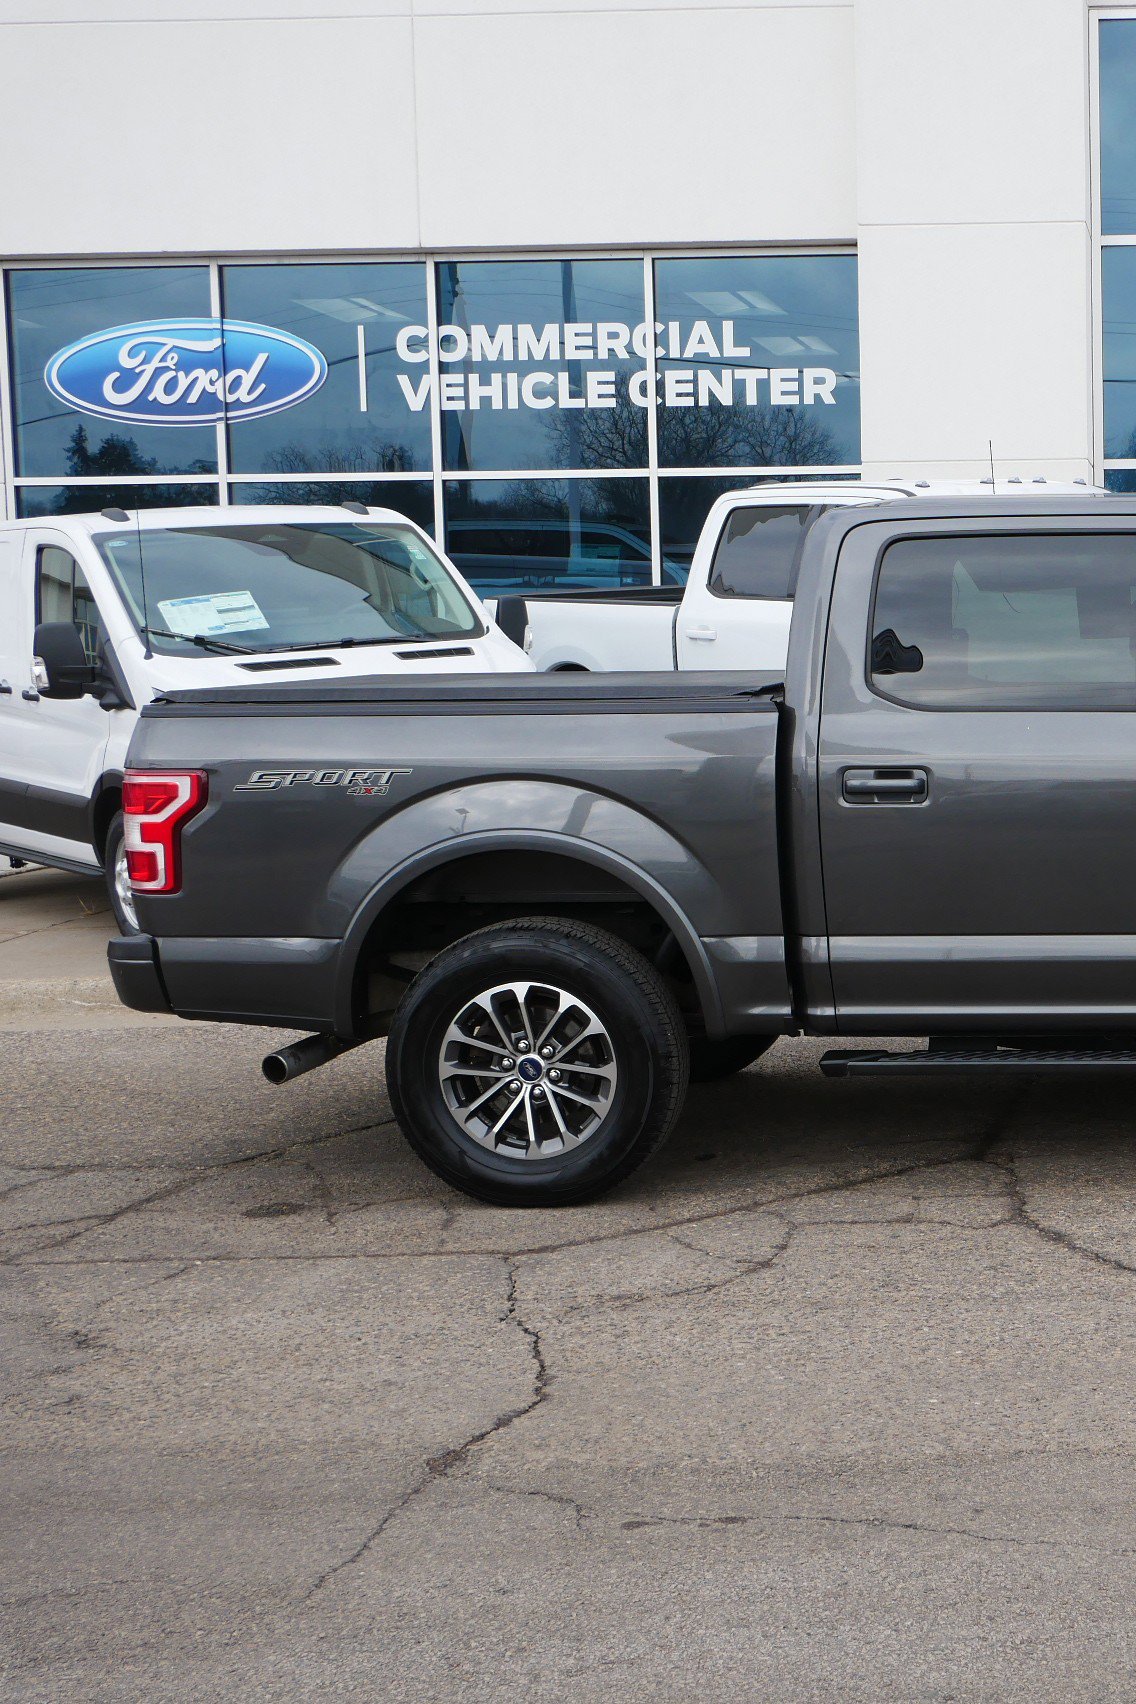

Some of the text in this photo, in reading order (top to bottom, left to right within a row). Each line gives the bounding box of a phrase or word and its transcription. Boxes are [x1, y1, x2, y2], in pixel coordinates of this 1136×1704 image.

[396, 320, 751, 363] COMMERCIAL
[102, 336, 269, 406] Ford
[396, 367, 837, 412] VEHICLE CENTER
[233, 768, 414, 792] SPORT
